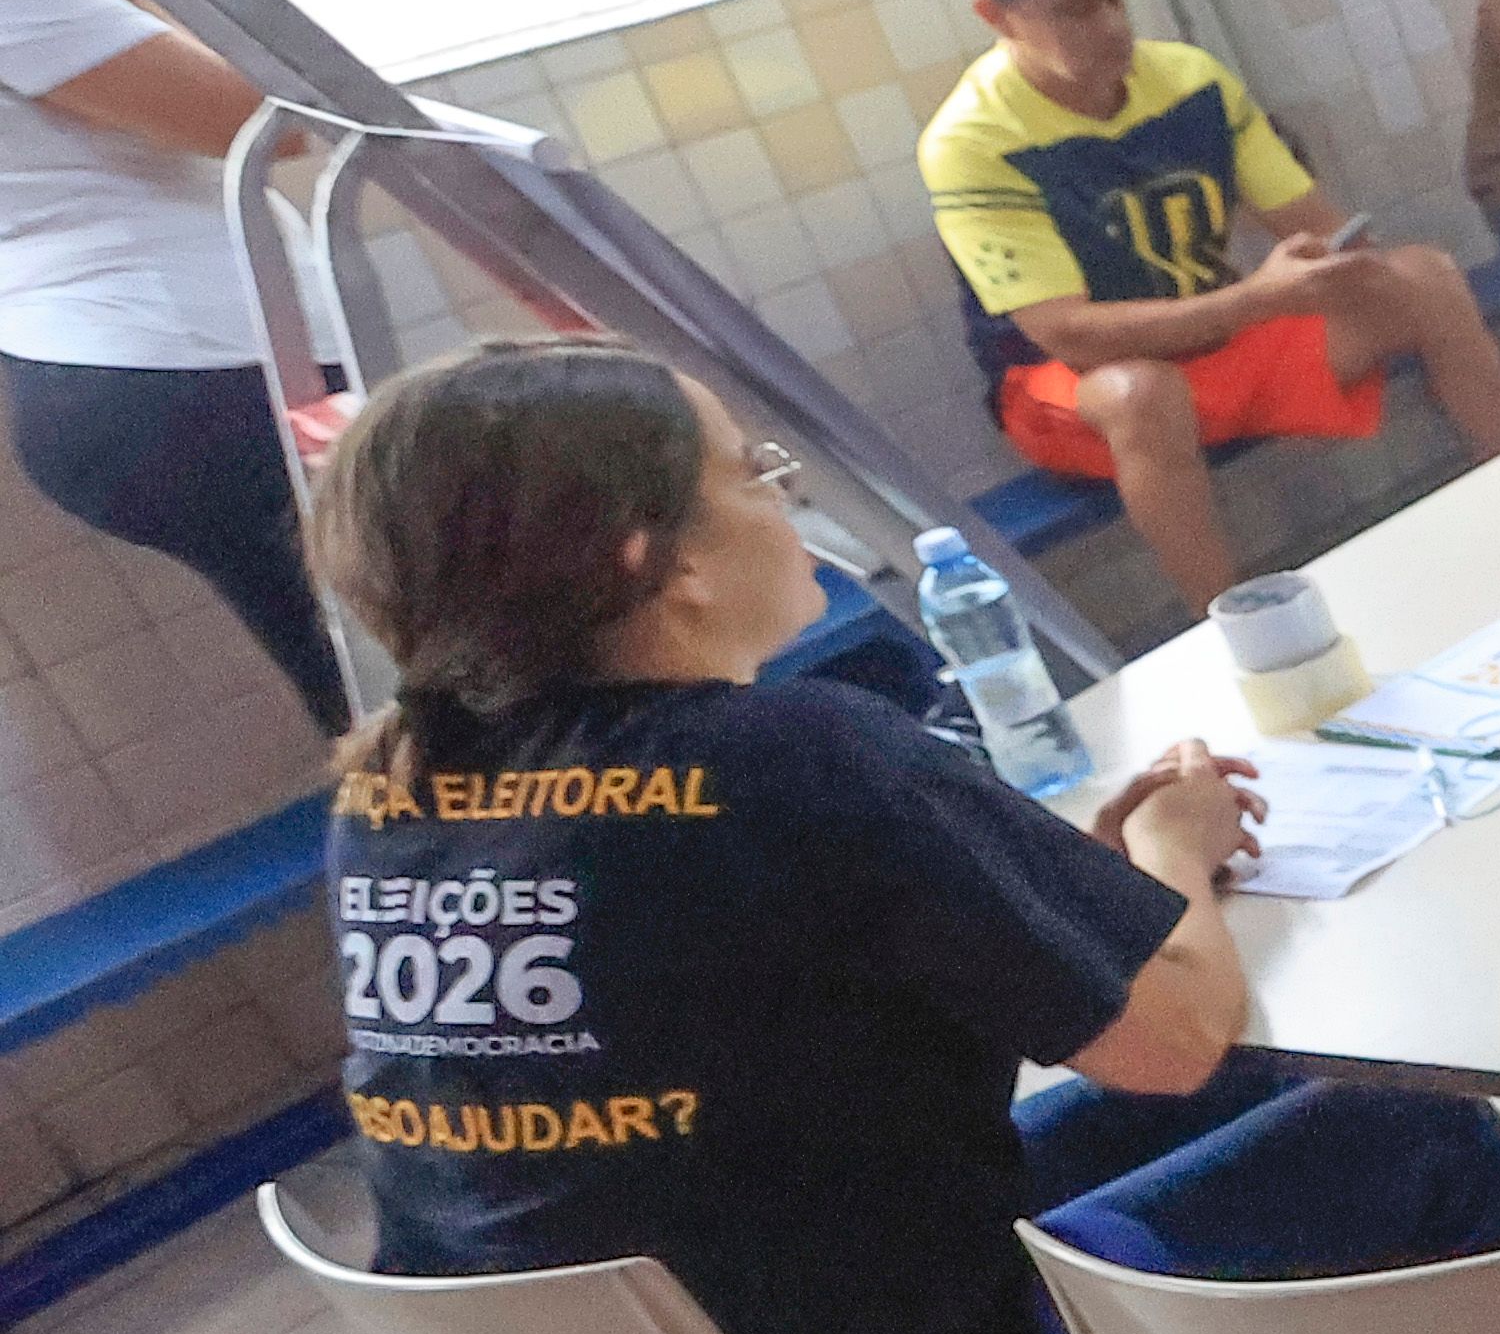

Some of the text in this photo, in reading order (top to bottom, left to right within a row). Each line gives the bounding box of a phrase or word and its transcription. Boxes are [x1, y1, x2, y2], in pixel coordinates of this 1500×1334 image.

[432, 767, 720, 820] ELEITORAL
[338, 867, 579, 938] ELEIÇÕES
[341, 929, 584, 1025] 2026
